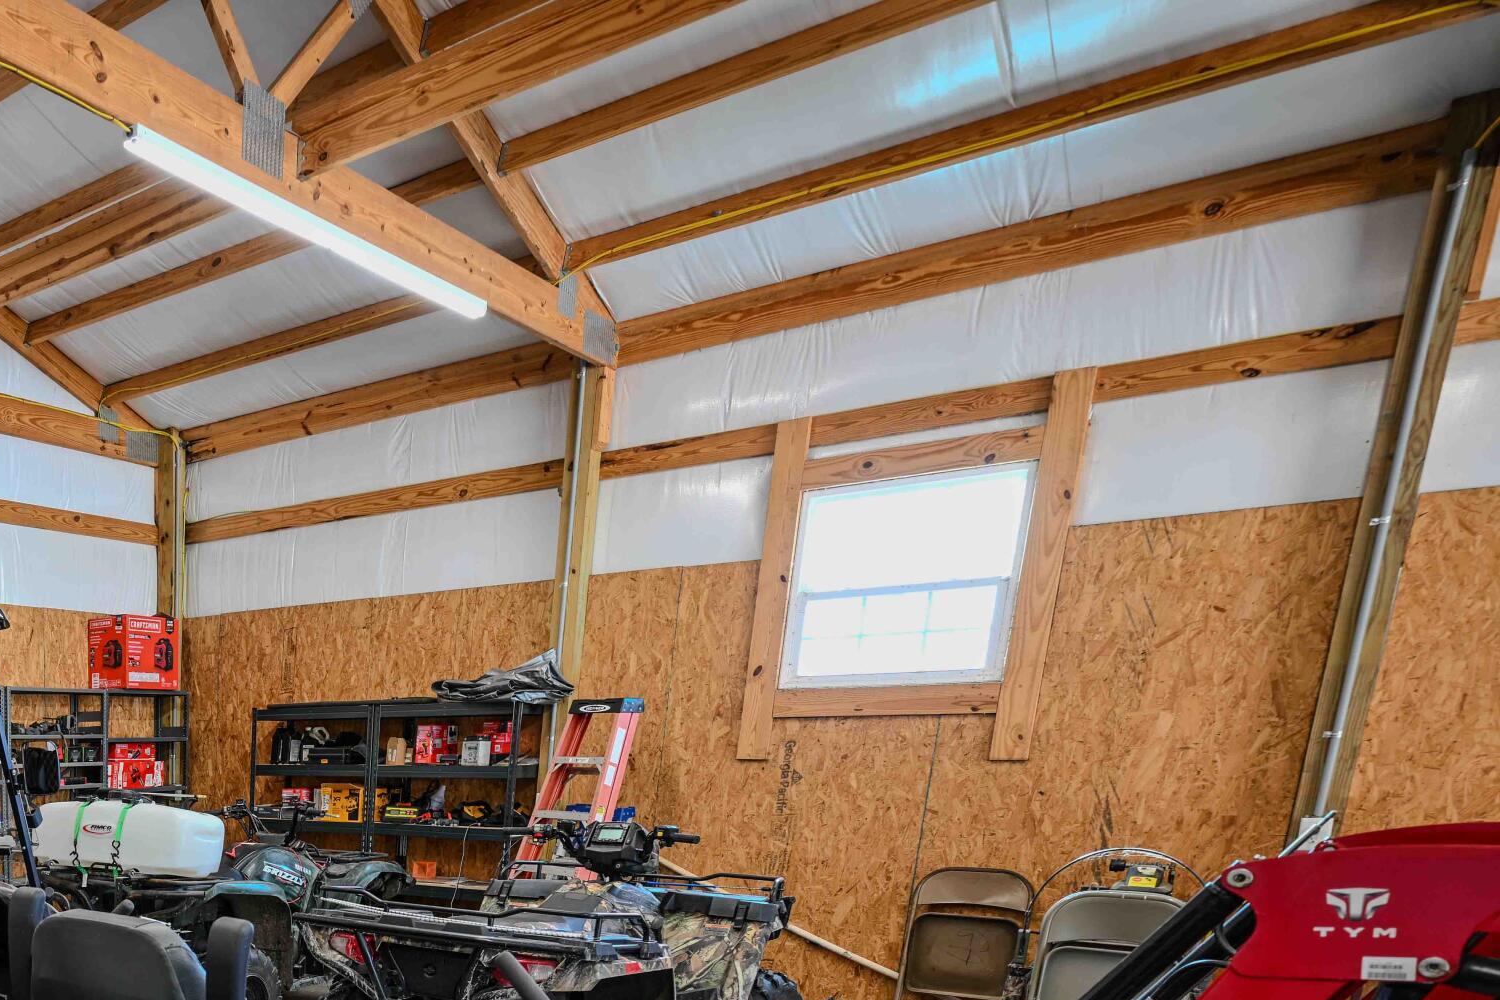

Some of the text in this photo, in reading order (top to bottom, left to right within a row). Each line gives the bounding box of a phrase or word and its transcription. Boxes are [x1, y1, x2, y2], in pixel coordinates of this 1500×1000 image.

[130, 620, 160, 630] CRAFTSMAN
[263, 865, 304, 886] GRIZZLY
[1312, 926, 1397, 938] TYM
